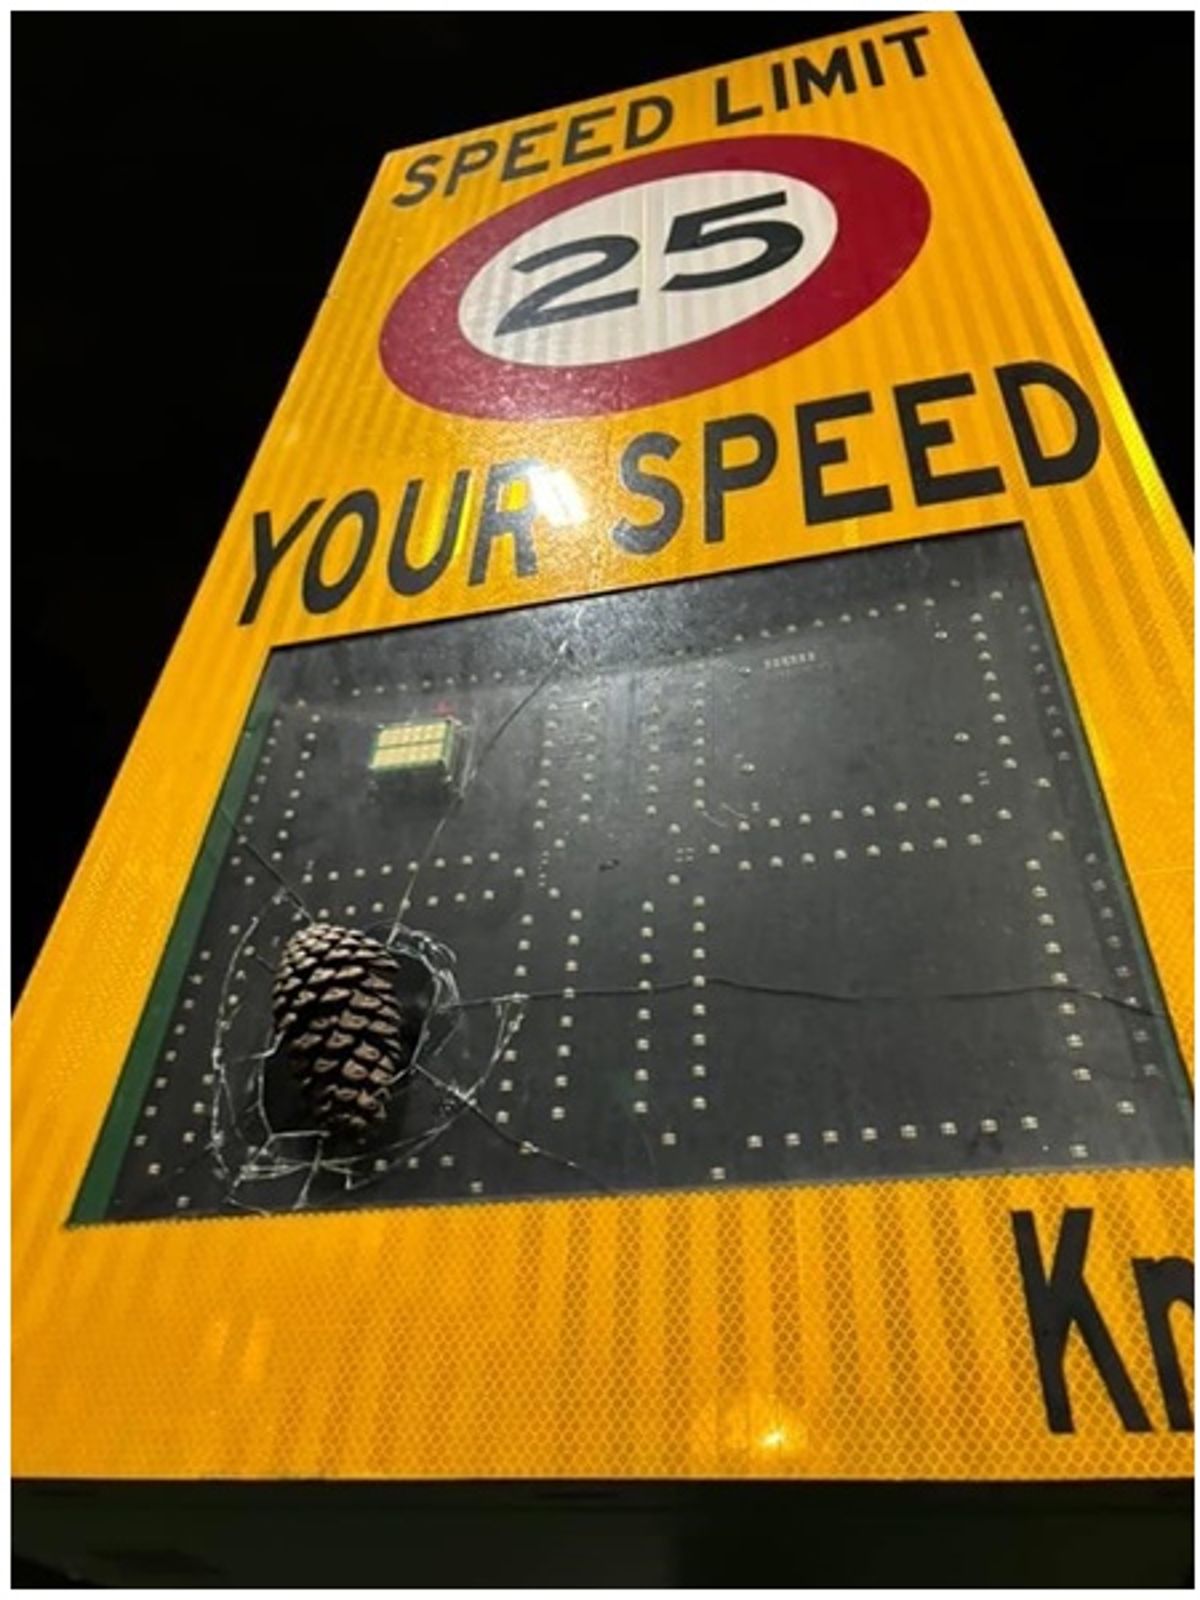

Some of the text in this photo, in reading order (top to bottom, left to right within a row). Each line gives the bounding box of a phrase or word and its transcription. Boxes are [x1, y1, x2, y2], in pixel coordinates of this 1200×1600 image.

[392, 26, 931, 208] SPEED LIMIT
[494, 191, 804, 337] 25
[236, 361, 1101, 626] YOUR SPEED
